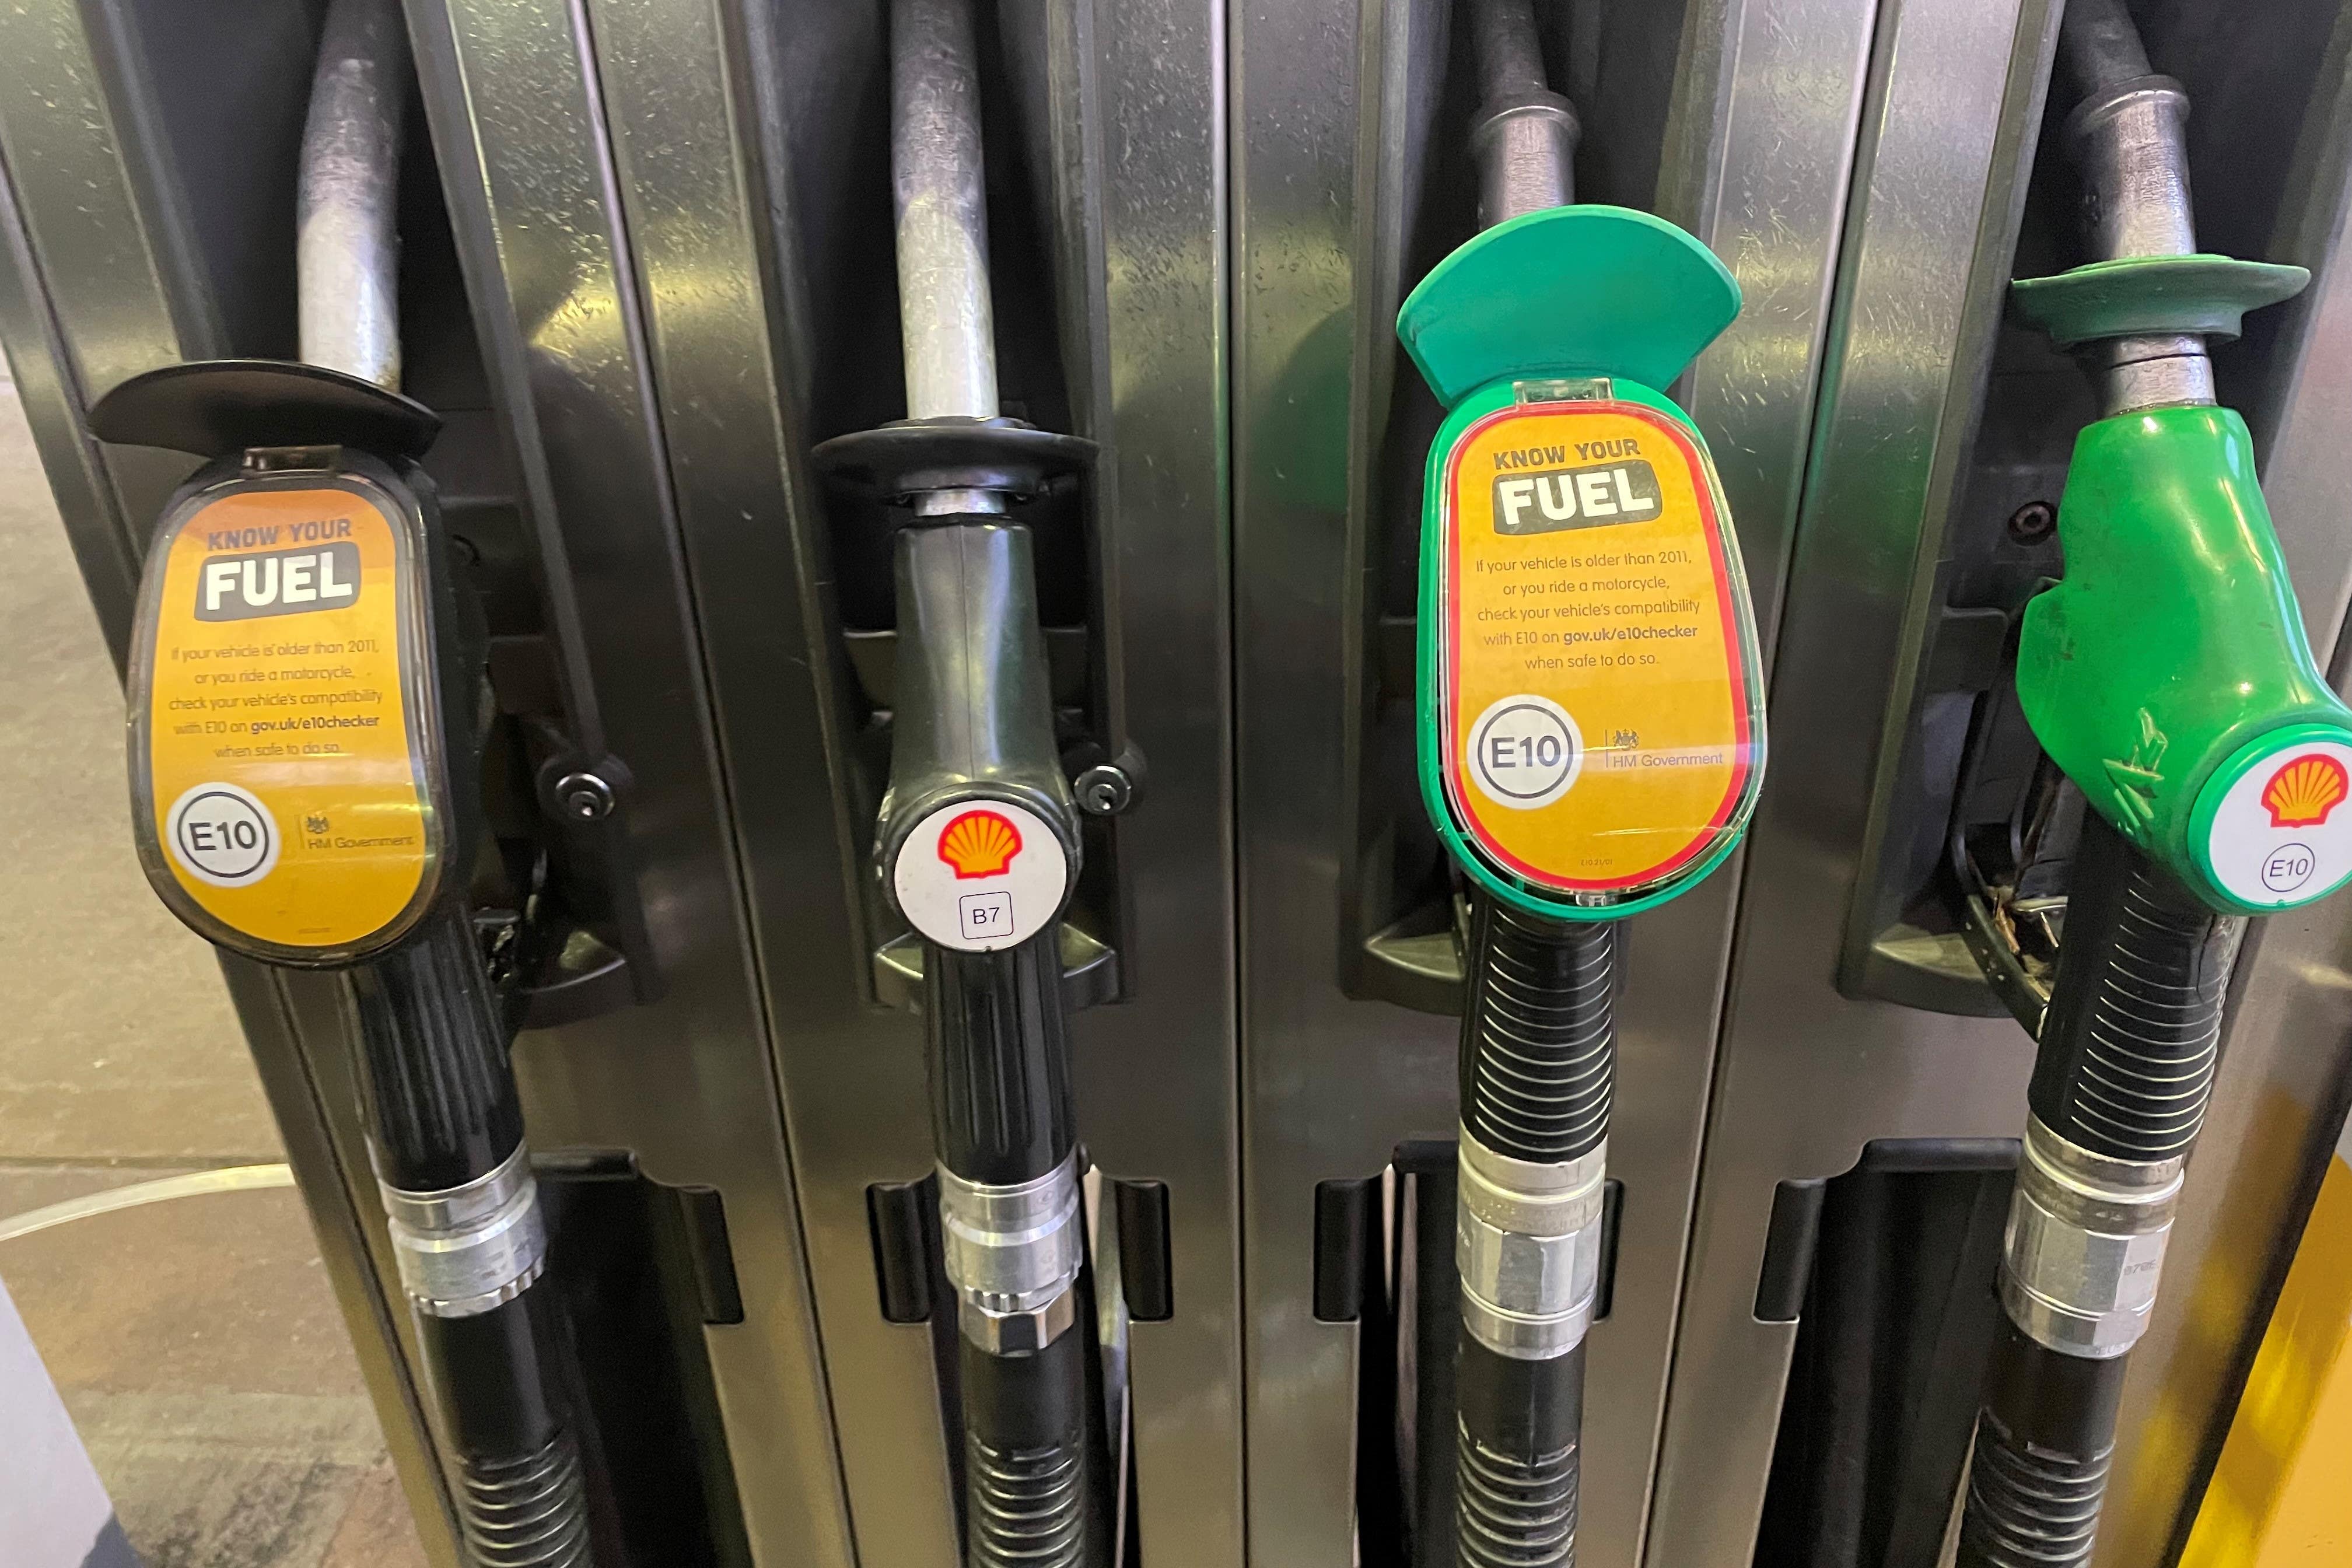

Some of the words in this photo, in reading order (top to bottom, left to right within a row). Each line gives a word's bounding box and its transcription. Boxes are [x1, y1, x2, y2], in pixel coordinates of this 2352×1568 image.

[1493, 446, 1565, 470] KNOW
[1574, 439, 1640, 460] YOUR
[1500, 469, 1654, 524] FUEL
[207, 526, 279, 550] KNOW
[289, 519, 352, 542] YOUR
[1477, 560, 1483, 572] If
[1488, 562, 1517, 574] your
[1520, 556, 1567, 569] vehicle
[1571, 556, 1581, 568] is
[1586, 554, 1620, 567] older
[1625, 553, 1654, 565] than
[1659, 551, 1691, 564] 2011,
[206, 552, 352, 610] FUEL
[1503, 586, 1516, 594] or
[1521, 584, 1544, 597] you
[1550, 580, 1575, 593] ride
[1580, 582, 1587, 591] a
[1592, 576, 1670, 592] motorcycle,
[1478, 607, 1517, 621] check
[1520, 608, 1549, 622] your
[1554, 603, 1610, 617] vehicle's
[1615, 599, 1699, 617] compatibility
[1484, 632, 1511, 645] with
[1517, 632, 1537, 644] E10
[1542, 634, 1559, 643] on
[1564, 625, 1698, 645] gov.uk/e10checker
[181, 649, 210, 662] your
[215, 644, 260, 658] vehicle
[264, 644, 275, 656] is
[277, 643, 311, 655] older
[314, 642, 344, 654] than
[1525, 656, 1563, 669] when
[1568, 654, 1596, 667] safe
[1601, 654, 1613, 666] to
[1618, 653, 1634, 665] do
[1640, 655, 1658, 664] so.
[195, 674, 209, 684] or
[211, 674, 235, 686] you
[240, 669, 265, 682] ride
[268, 671, 277, 680] a
[169, 696, 206, 710] check
[210, 698, 239, 711] your
[243, 694, 296, 706] vehicle's
[300, 690, 382, 706] compatibility
[205, 721, 227, 733] E10
[230, 723, 247, 732] on
[251, 715, 380, 734] gov.uk/e10checker
[214, 745, 251, 757] when
[256, 744, 284, 756] safe
[286, 745, 299, 754] to
[303, 742, 320, 754] do
[1492, 736, 1560, 768] E10
[1614, 755, 1636, 767] HM
[1642, 753, 1722, 766] Government
[189, 821, 257, 850] E10
[335, 836, 414, 848] Government
[2269, 858, 2308, 878] E10
[972, 907, 1000, 925] B7
